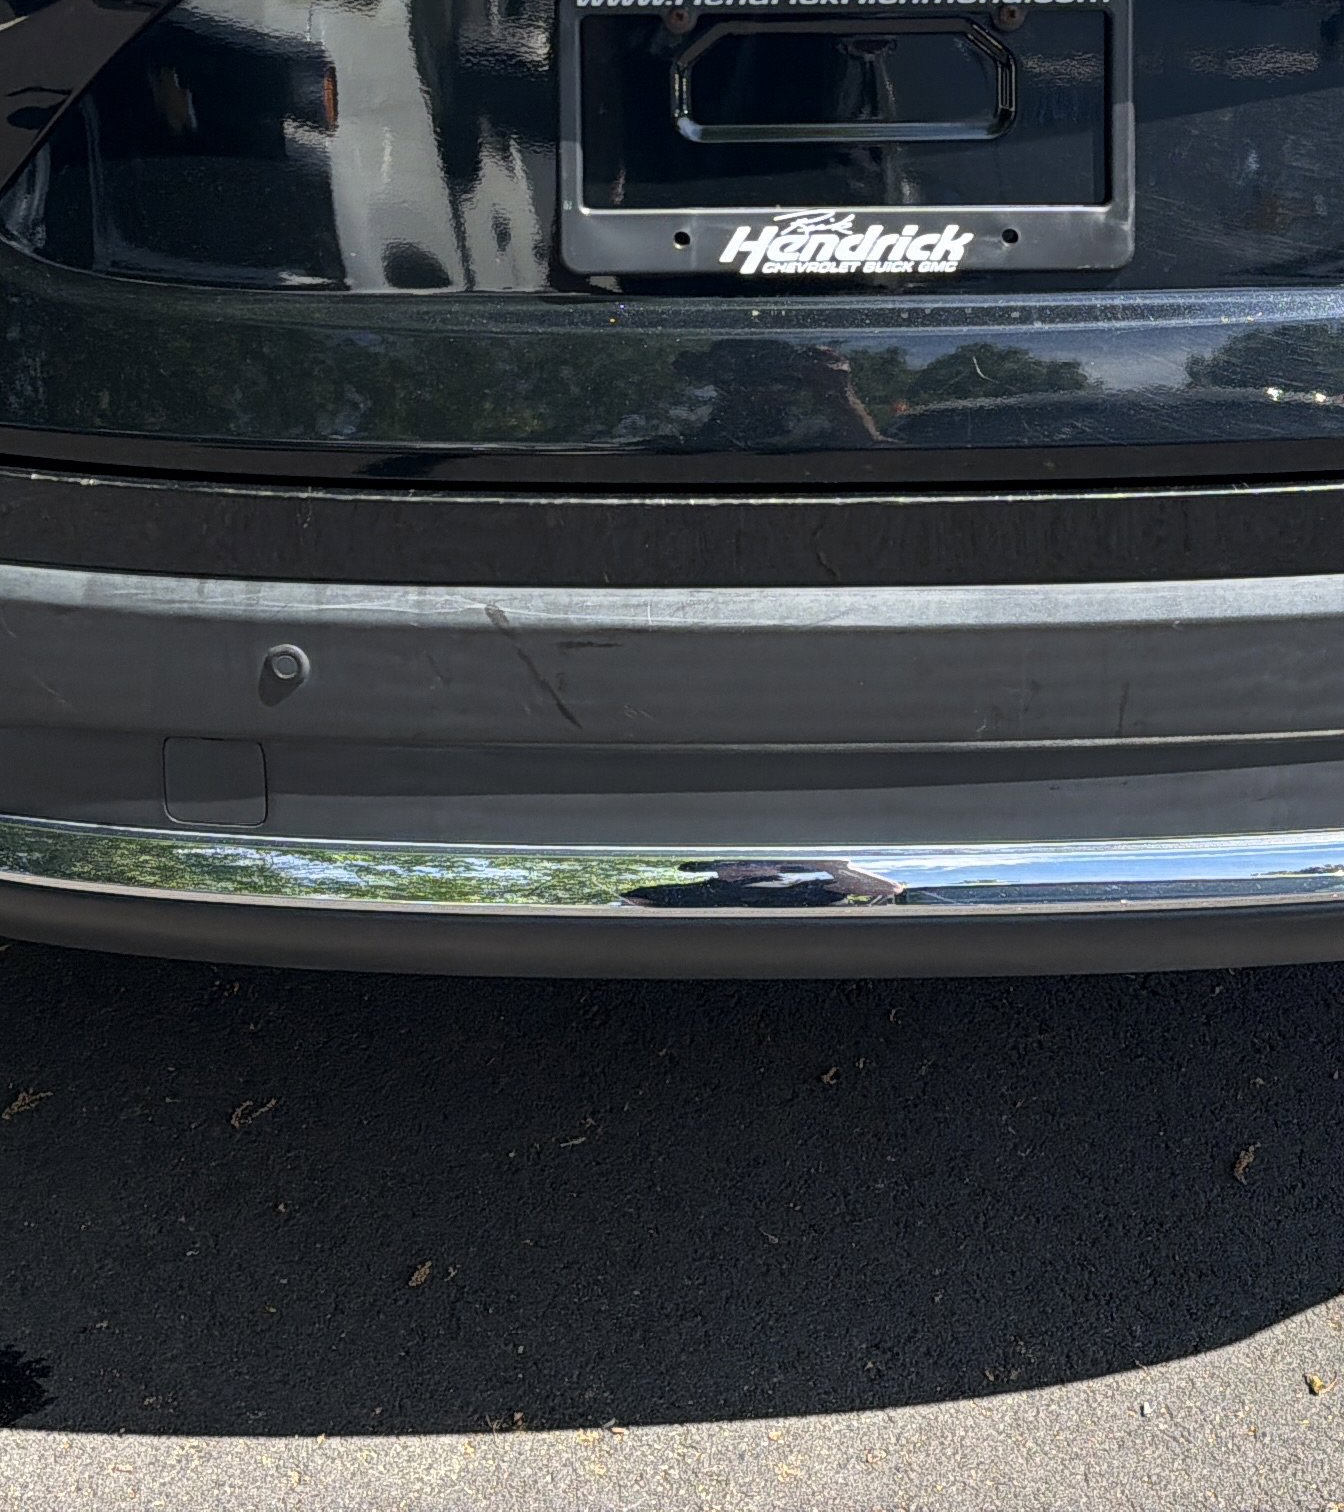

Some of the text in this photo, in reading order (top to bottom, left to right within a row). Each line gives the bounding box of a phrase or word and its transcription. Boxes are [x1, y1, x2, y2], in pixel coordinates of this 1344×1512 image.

[719, 224, 974, 275] Hendrick
[762, 261, 958, 274] CHEVROLET BUICK GMC
